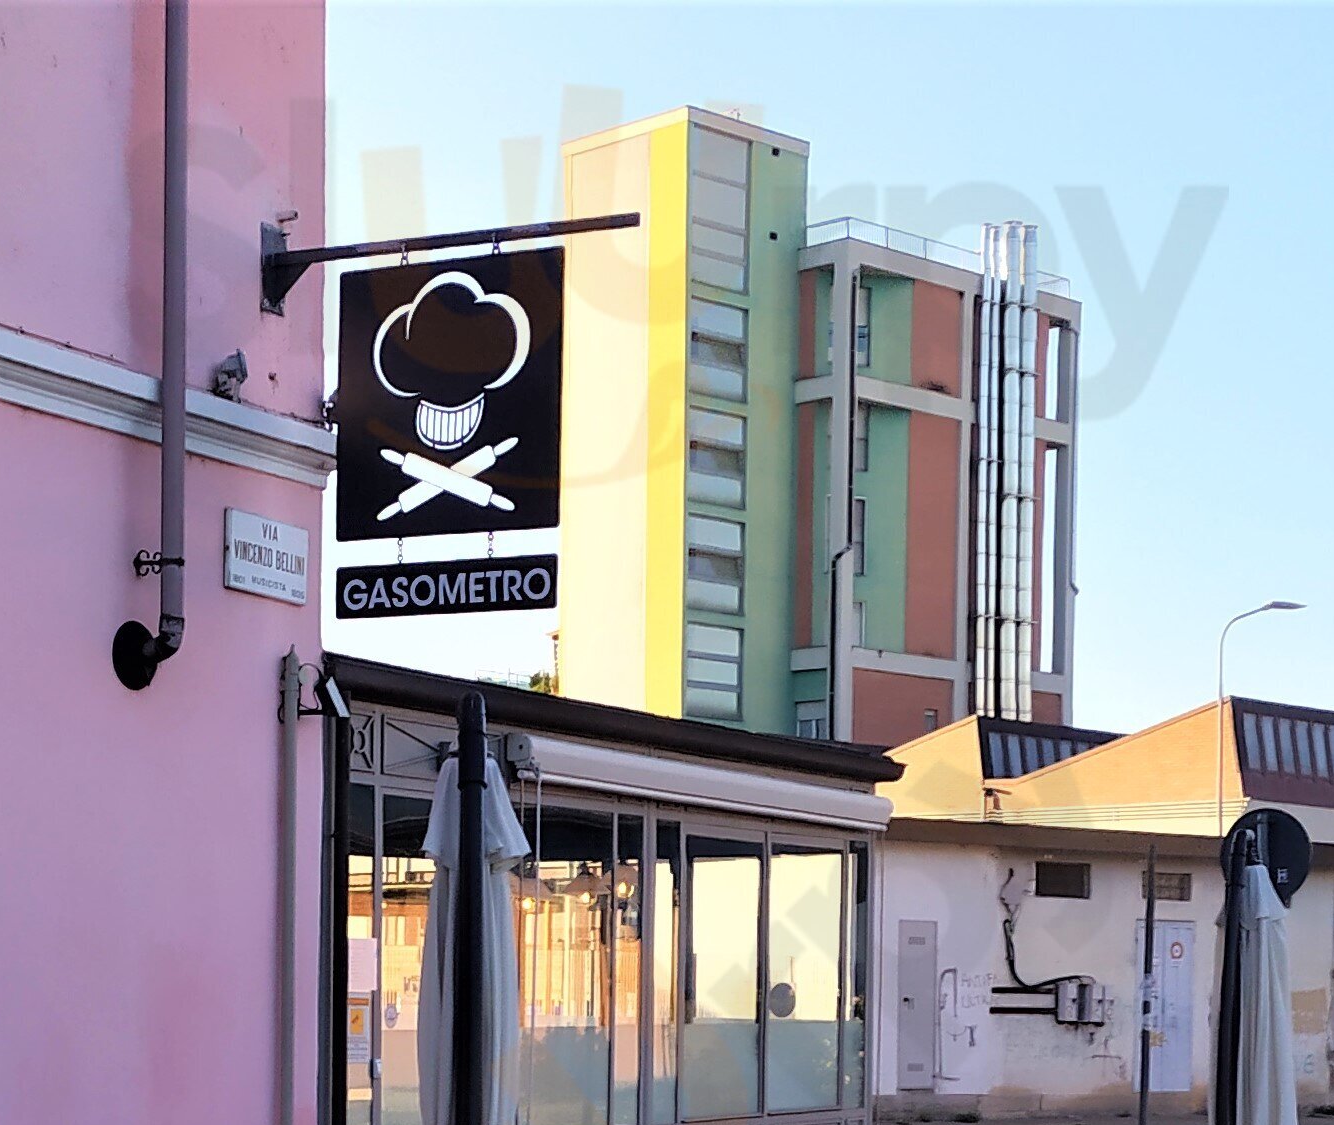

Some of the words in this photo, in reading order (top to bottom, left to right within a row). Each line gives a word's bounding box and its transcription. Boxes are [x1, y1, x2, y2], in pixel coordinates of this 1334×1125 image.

[262, 522, 279, 541] VIA
[234, 538, 273, 569] VINCENZO
[275, 550, 305, 576] BELLINI
[251, 575, 287, 592] MUSICISTA
[343, 568, 551, 611] GASOMETRO
